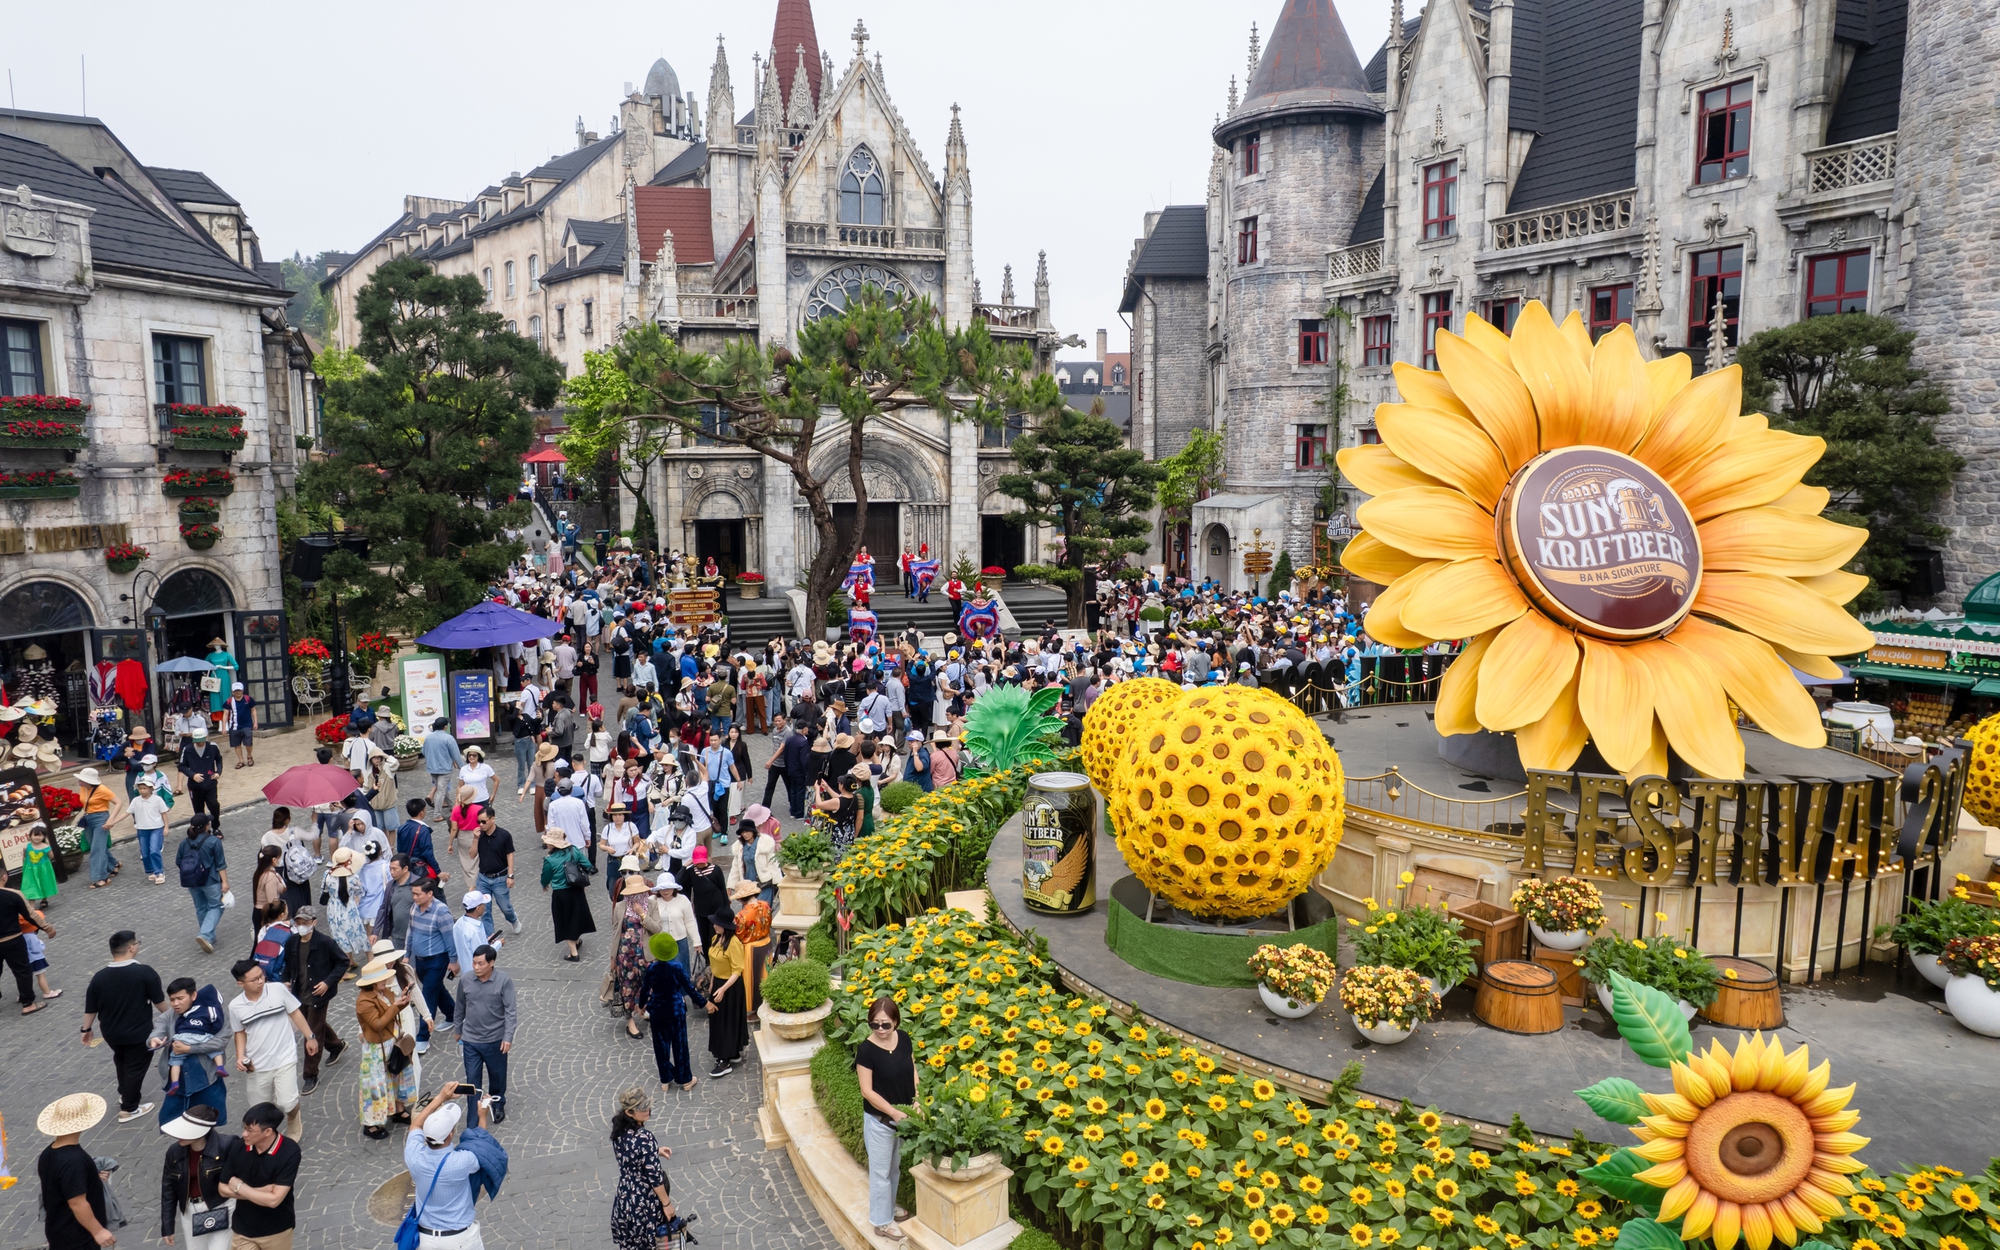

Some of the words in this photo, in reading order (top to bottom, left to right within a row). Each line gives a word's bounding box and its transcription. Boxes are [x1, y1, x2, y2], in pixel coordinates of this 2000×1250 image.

[1564, 471, 1577, 480] MADE
[1540, 497, 1616, 538] SUN
[1536, 531, 1687, 568] KRAFTBEER
[1579, 572, 1594, 582] BA
[1596, 571, 1610, 581] NA
[1612, 563, 1662, 579] SIGNATURE
[1877, 636, 1917, 645] COFFEE
[1929, 641, 1963, 649] FRESH
[1871, 649, 1887, 657] XIN
[1888, 650, 1912, 660] CHÀO
[1922, 654, 1940, 664] 你好
[1964, 657, 1978, 666] El
[1024, 811, 1036, 827] UN
[1521, 768, 1904, 887] FESTIVAL
[1, 839, 13, 849] Le
[14, 833, 31, 845] Pet
